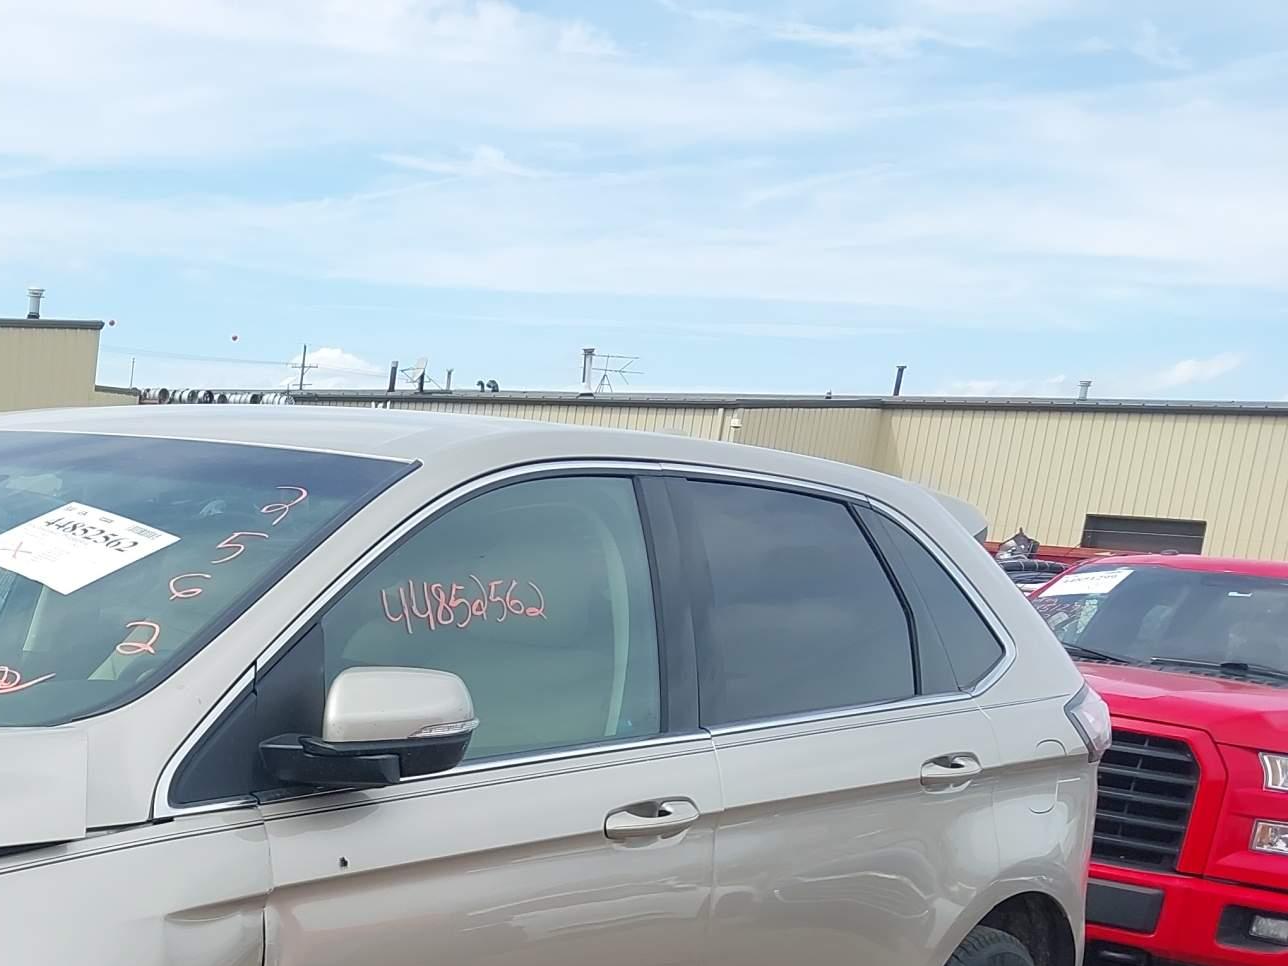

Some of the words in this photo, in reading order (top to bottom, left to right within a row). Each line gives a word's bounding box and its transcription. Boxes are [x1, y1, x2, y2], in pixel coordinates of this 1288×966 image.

[45, 517, 139, 552] 44852562
[210, 531, 270, 565] 5
[380, 574, 548, 635] 44852562
[115, 620, 161, 655] 2
